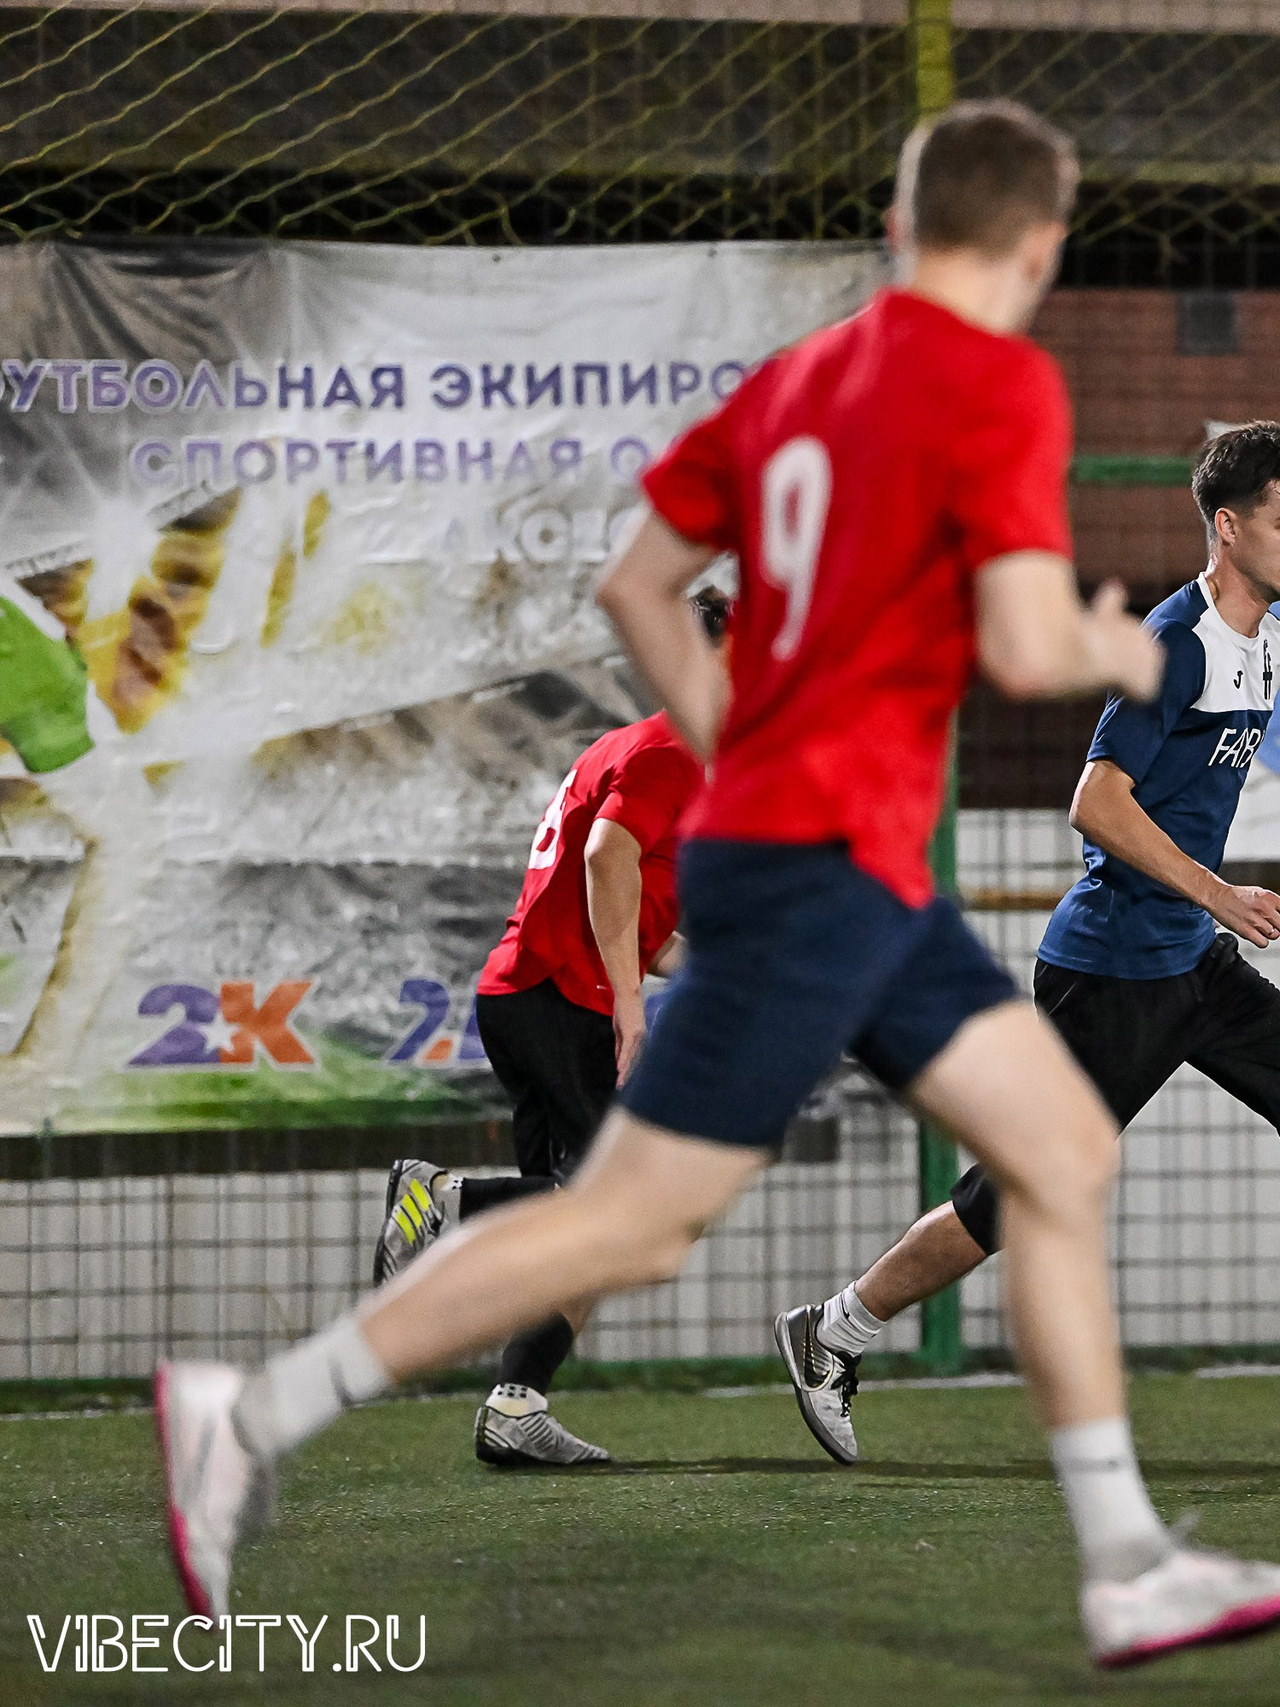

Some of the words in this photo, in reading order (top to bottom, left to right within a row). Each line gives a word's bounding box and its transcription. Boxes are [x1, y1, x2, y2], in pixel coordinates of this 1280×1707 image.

[0, 359, 405, 413] УТБОЛЬНАЯ
[132, 437, 585, 486] СПОРТИВНАЯ
[760, 432, 834, 661] 9
[1208, 727, 1265, 768] FAB
